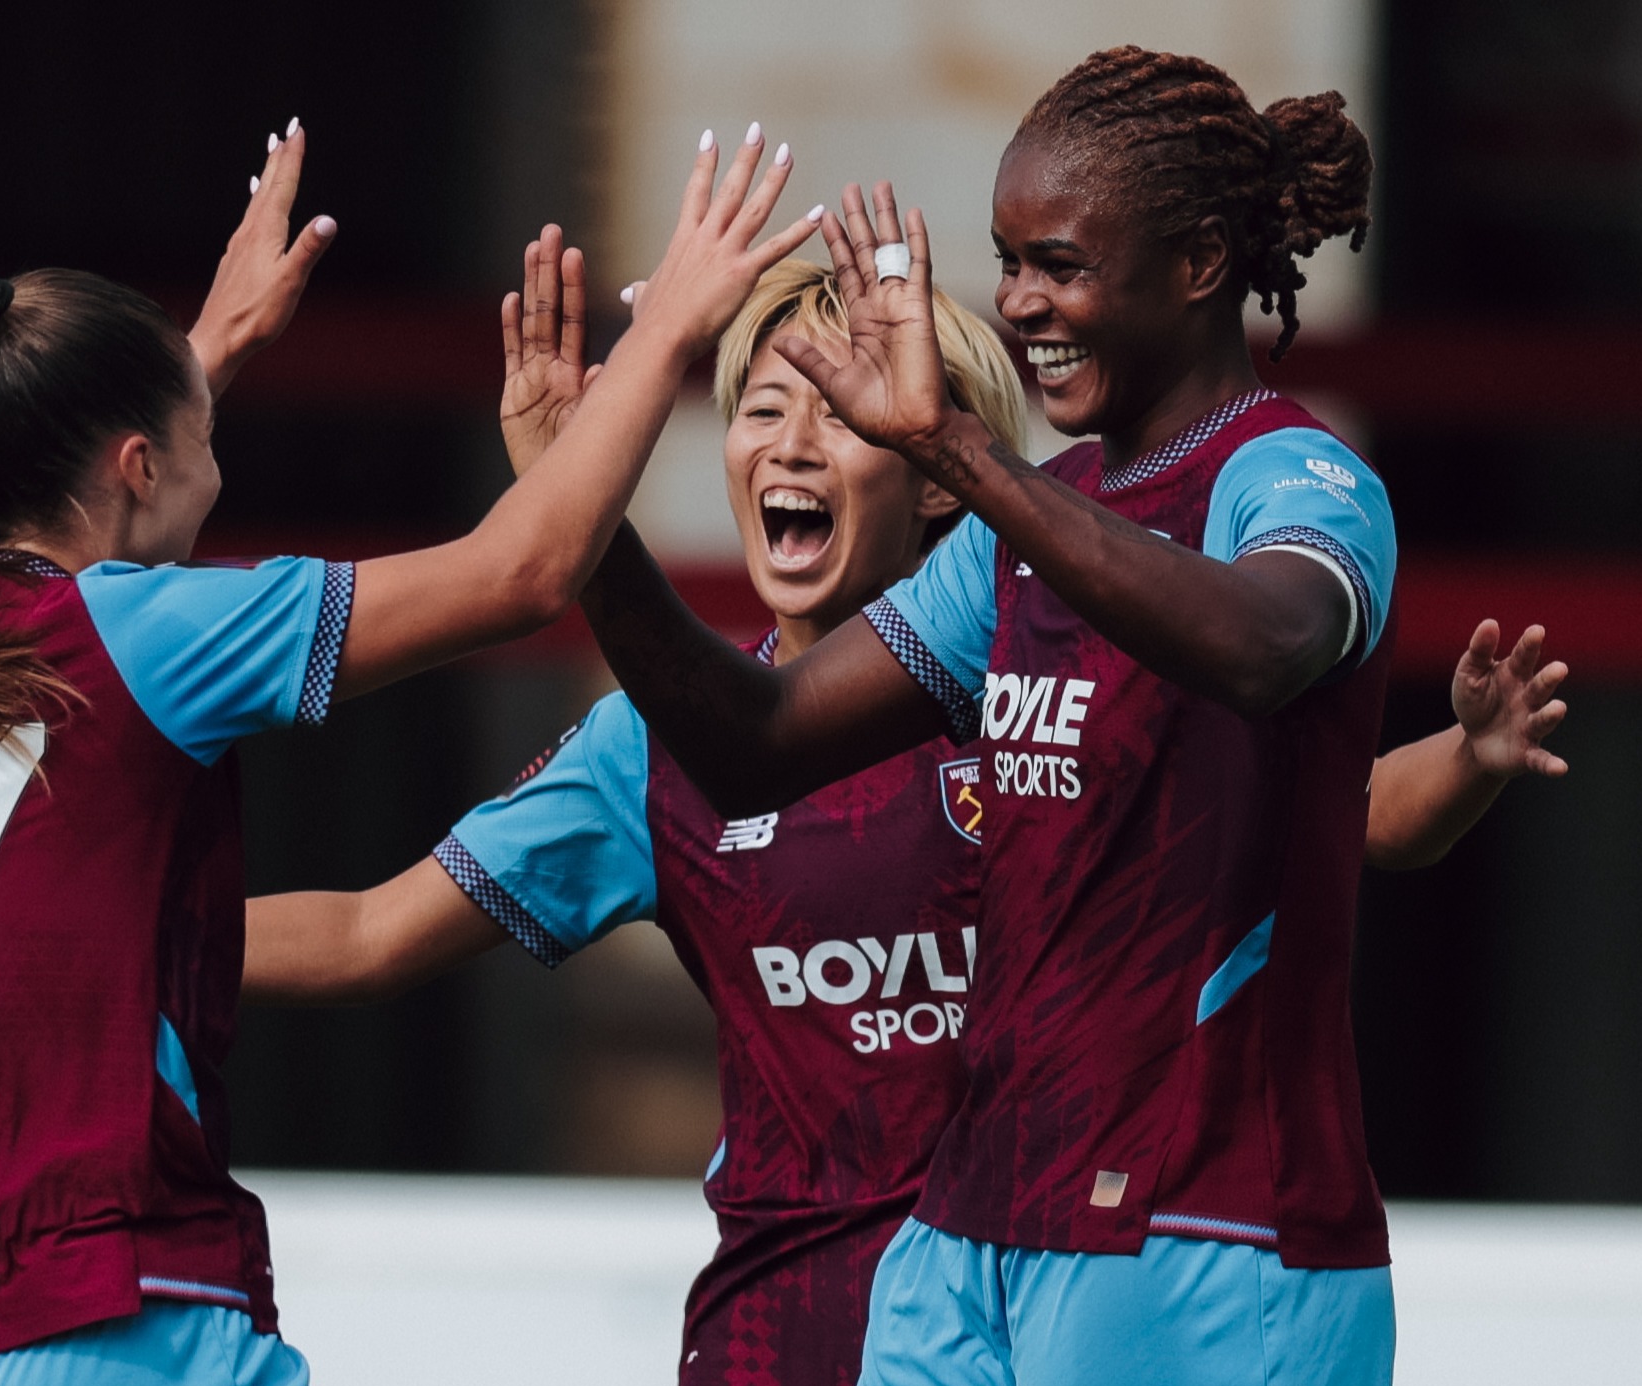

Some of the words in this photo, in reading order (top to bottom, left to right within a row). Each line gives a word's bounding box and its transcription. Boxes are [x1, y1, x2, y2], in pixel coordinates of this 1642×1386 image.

[949, 766, 980, 780] WEST
[963, 775, 980, 785] UNI
[994, 751, 1082, 799] SPORTS
[850, 1002, 968, 1053] SPOR
